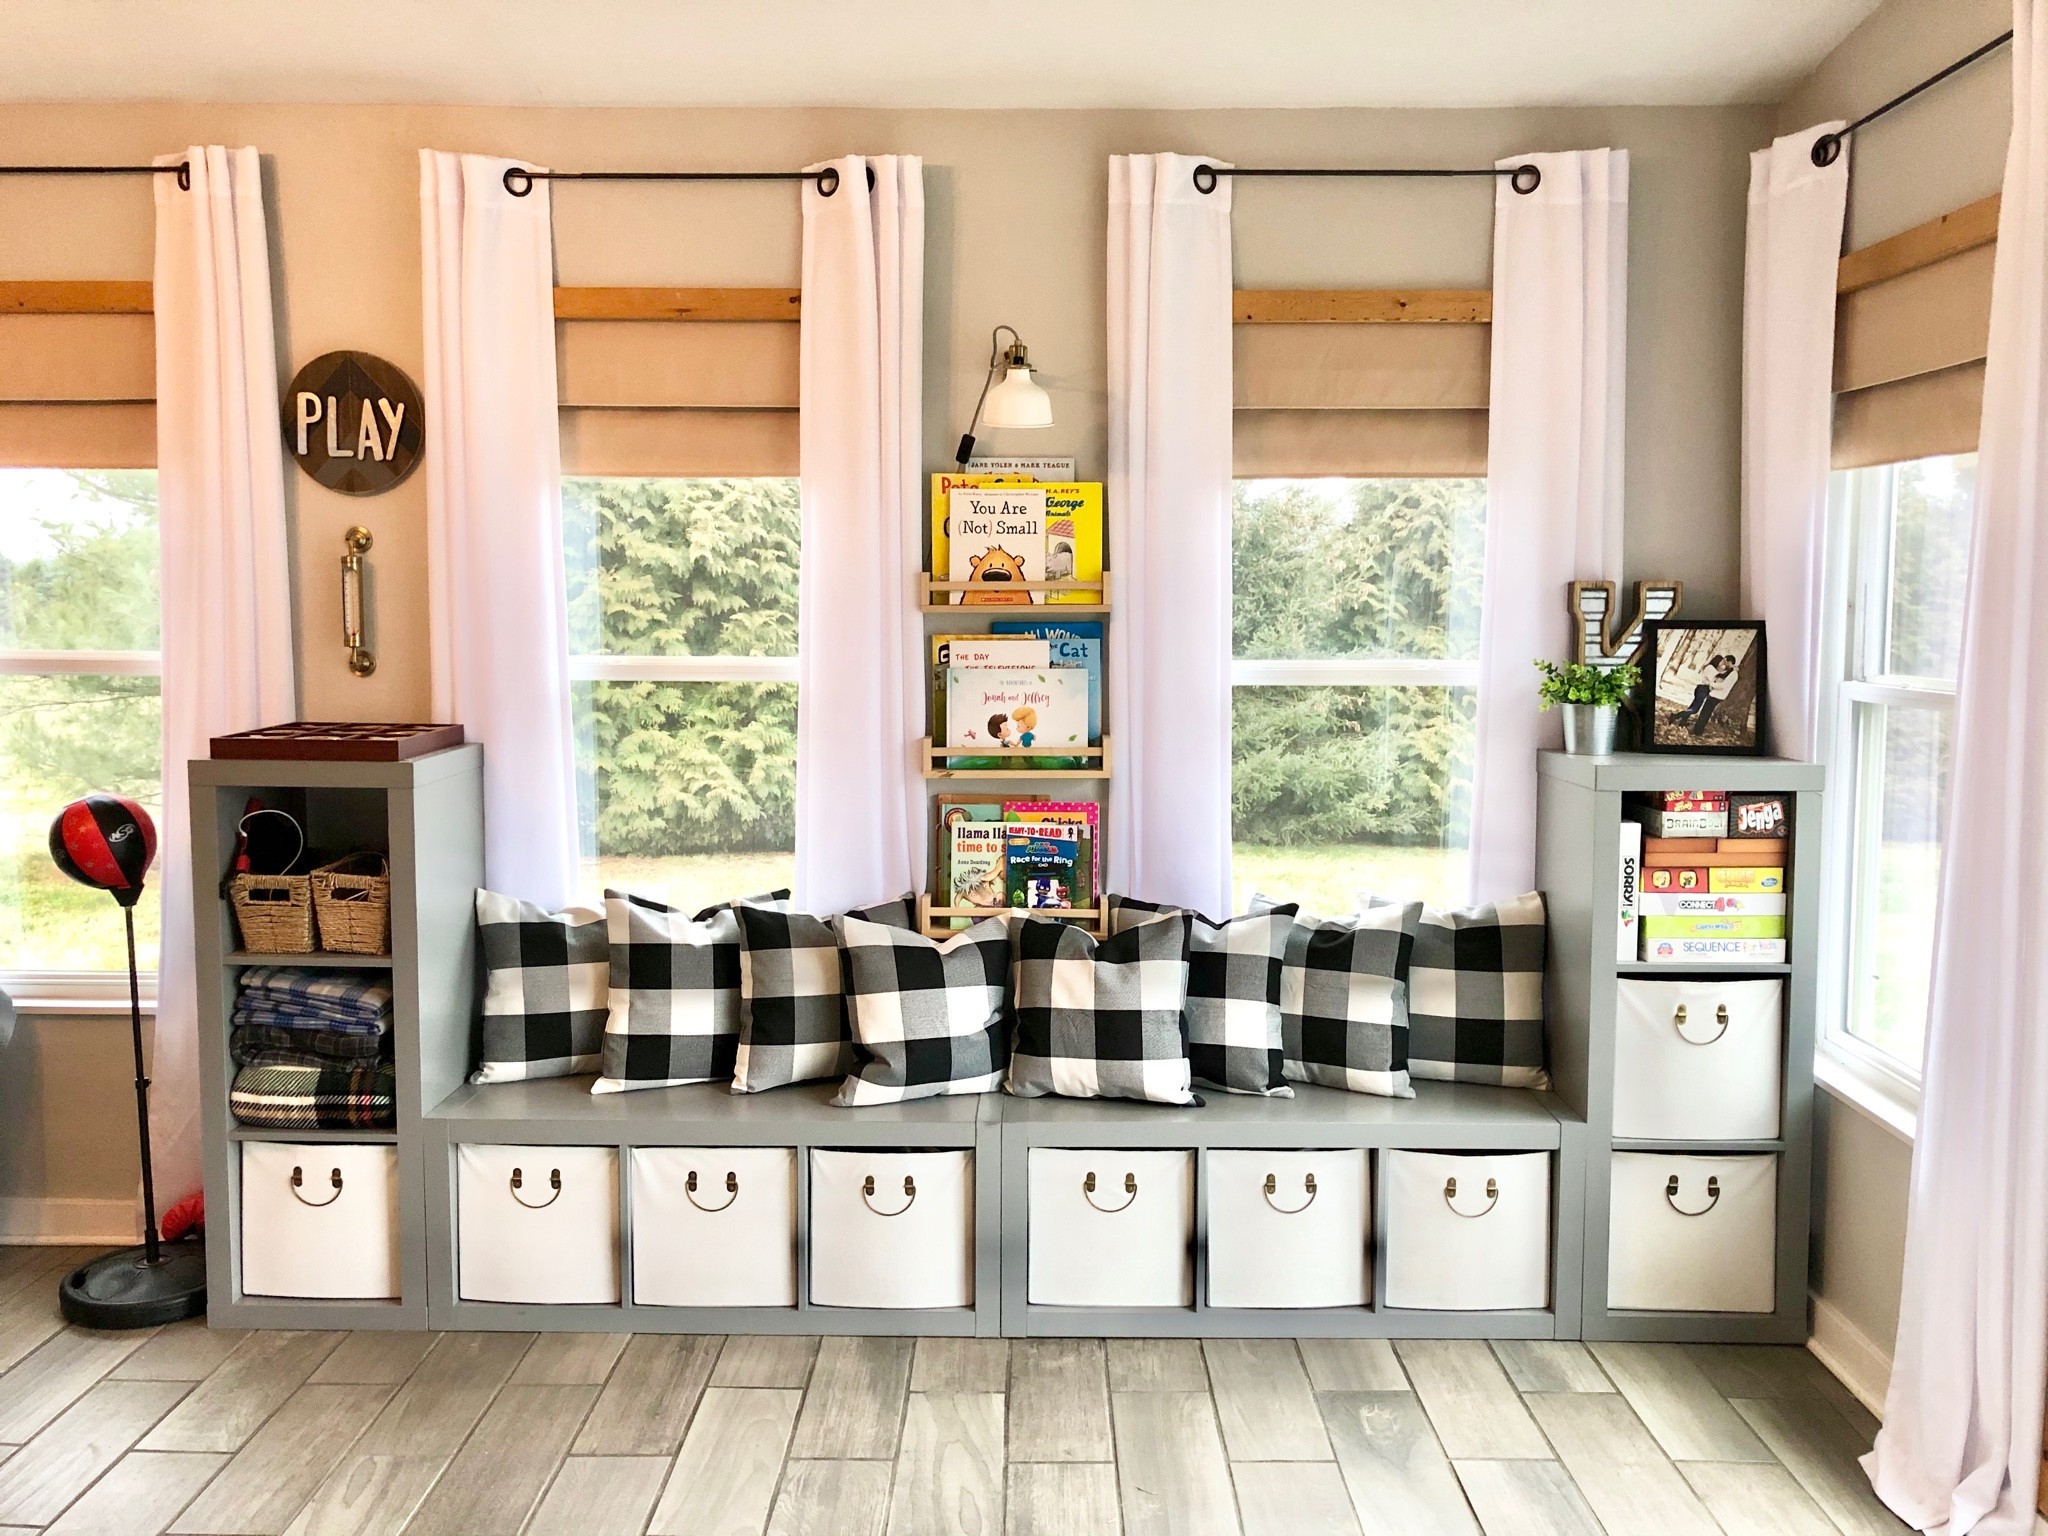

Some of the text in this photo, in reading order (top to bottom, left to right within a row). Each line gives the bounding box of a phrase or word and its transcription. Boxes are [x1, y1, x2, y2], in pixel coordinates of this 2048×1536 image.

[297, 391, 405, 462] PLAY
[969, 500, 1027, 515] You Are
[1045, 496, 1085, 512] George
[958, 519, 993, 538] (Not)
[996, 520, 1038, 535] Small
[955, 653, 990, 661] THE DAY
[1059, 642, 1089, 658] Cat
[1021, 691, 1050, 708] Jeffrey
[1739, 802, 1784, 832] Jenga
[957, 827, 990, 839] llama
[957, 840, 983, 853] time
[986, 842, 998, 853] to
[1010, 855, 1031, 865] Race
[1031, 855, 1042, 863] for
[1053, 855, 1074, 868] Ring
[1622, 857, 1635, 907] SORRY!
[1679, 897, 1725, 912] CONNECT 4
[1683, 941, 1741, 953] SEQUENCE
